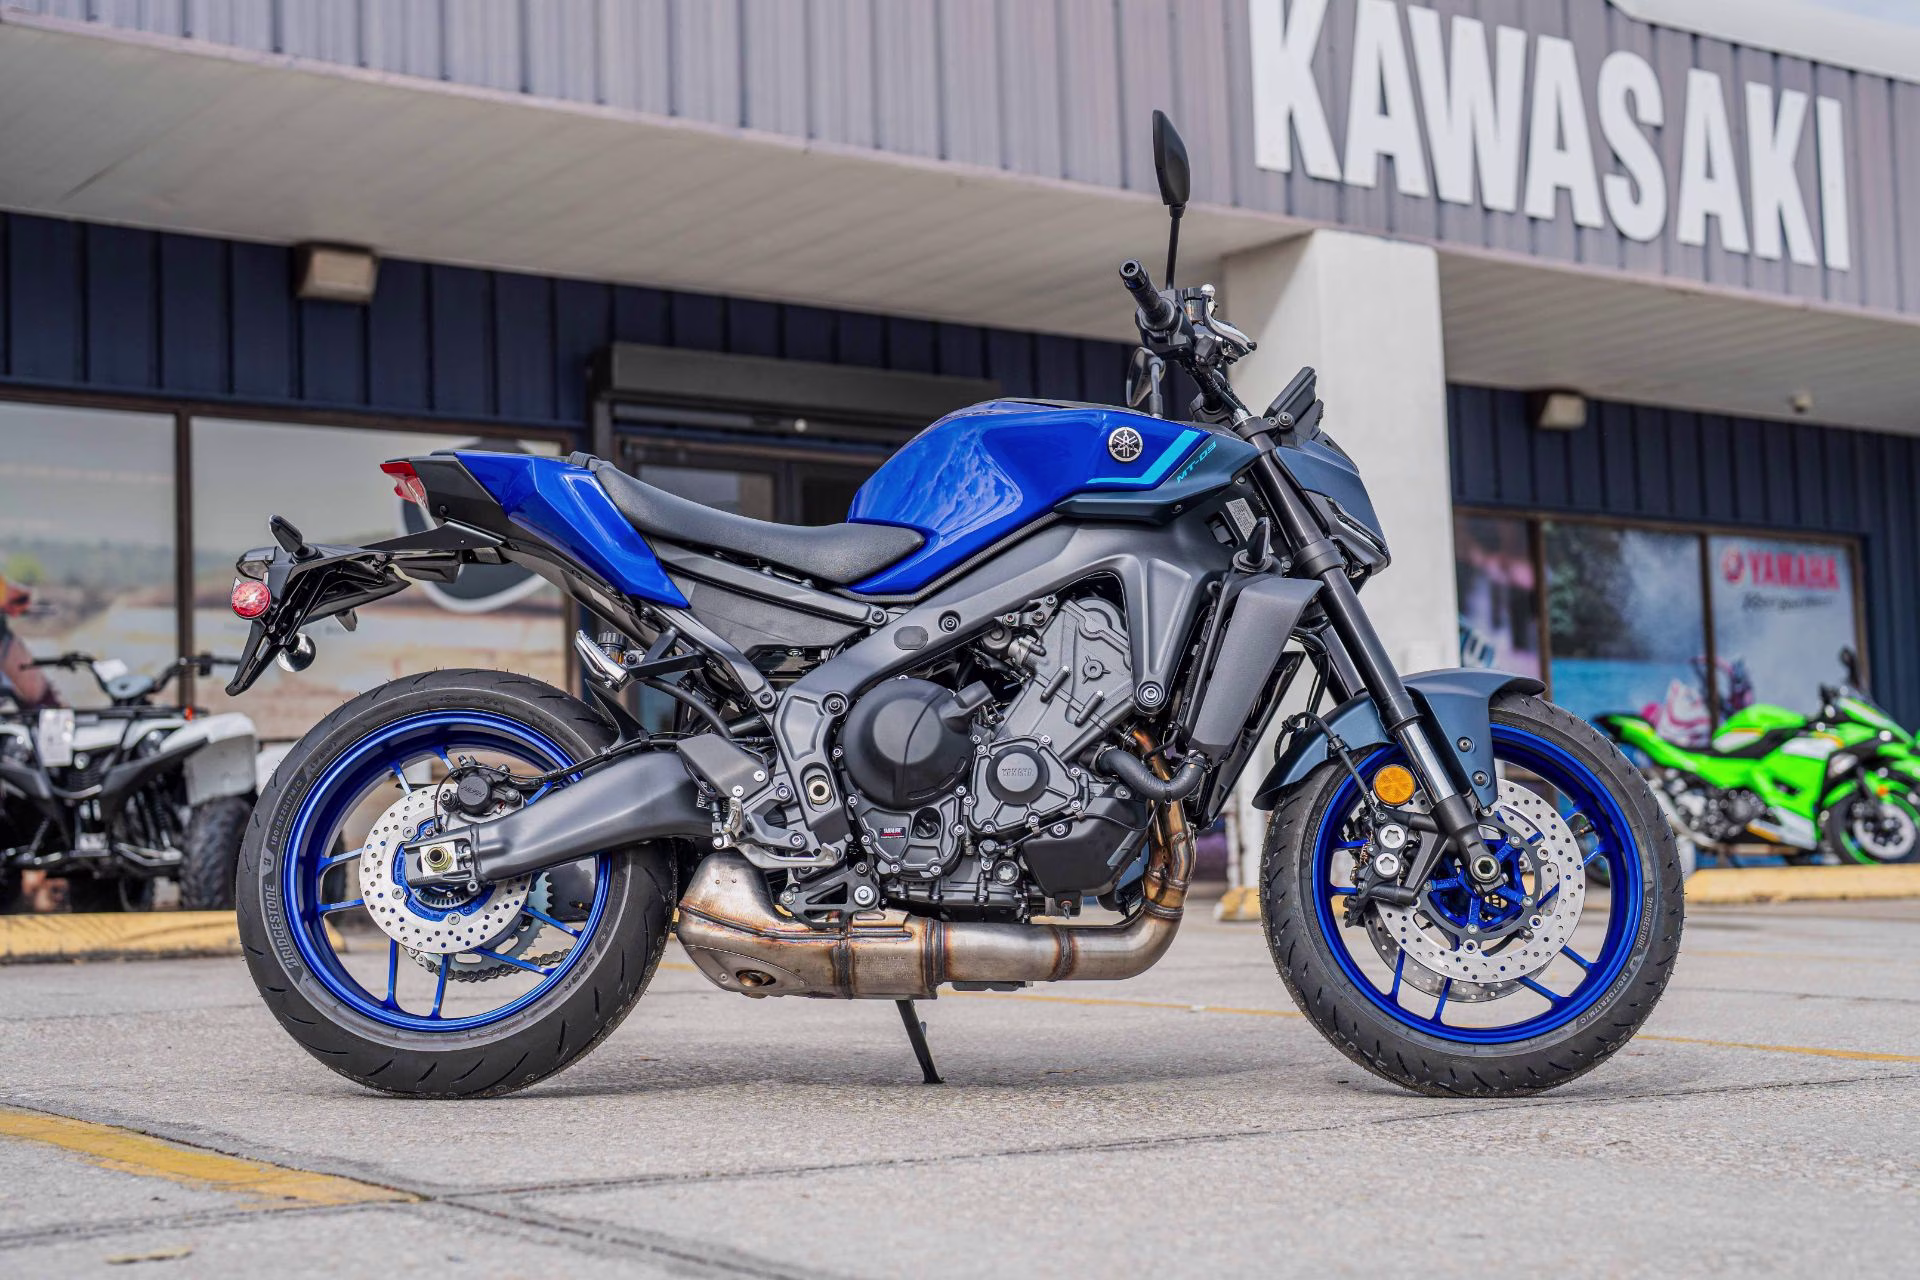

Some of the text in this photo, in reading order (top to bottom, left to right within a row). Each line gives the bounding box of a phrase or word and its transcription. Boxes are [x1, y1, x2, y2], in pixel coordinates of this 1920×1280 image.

[1249, 0, 1850, 271] KAWASAKI
[1175, 440, 1217, 485] MT-09
[265, 883, 299, 969] BRIDGESTONE
[1637, 896, 1654, 950] BRIDGESTONE
